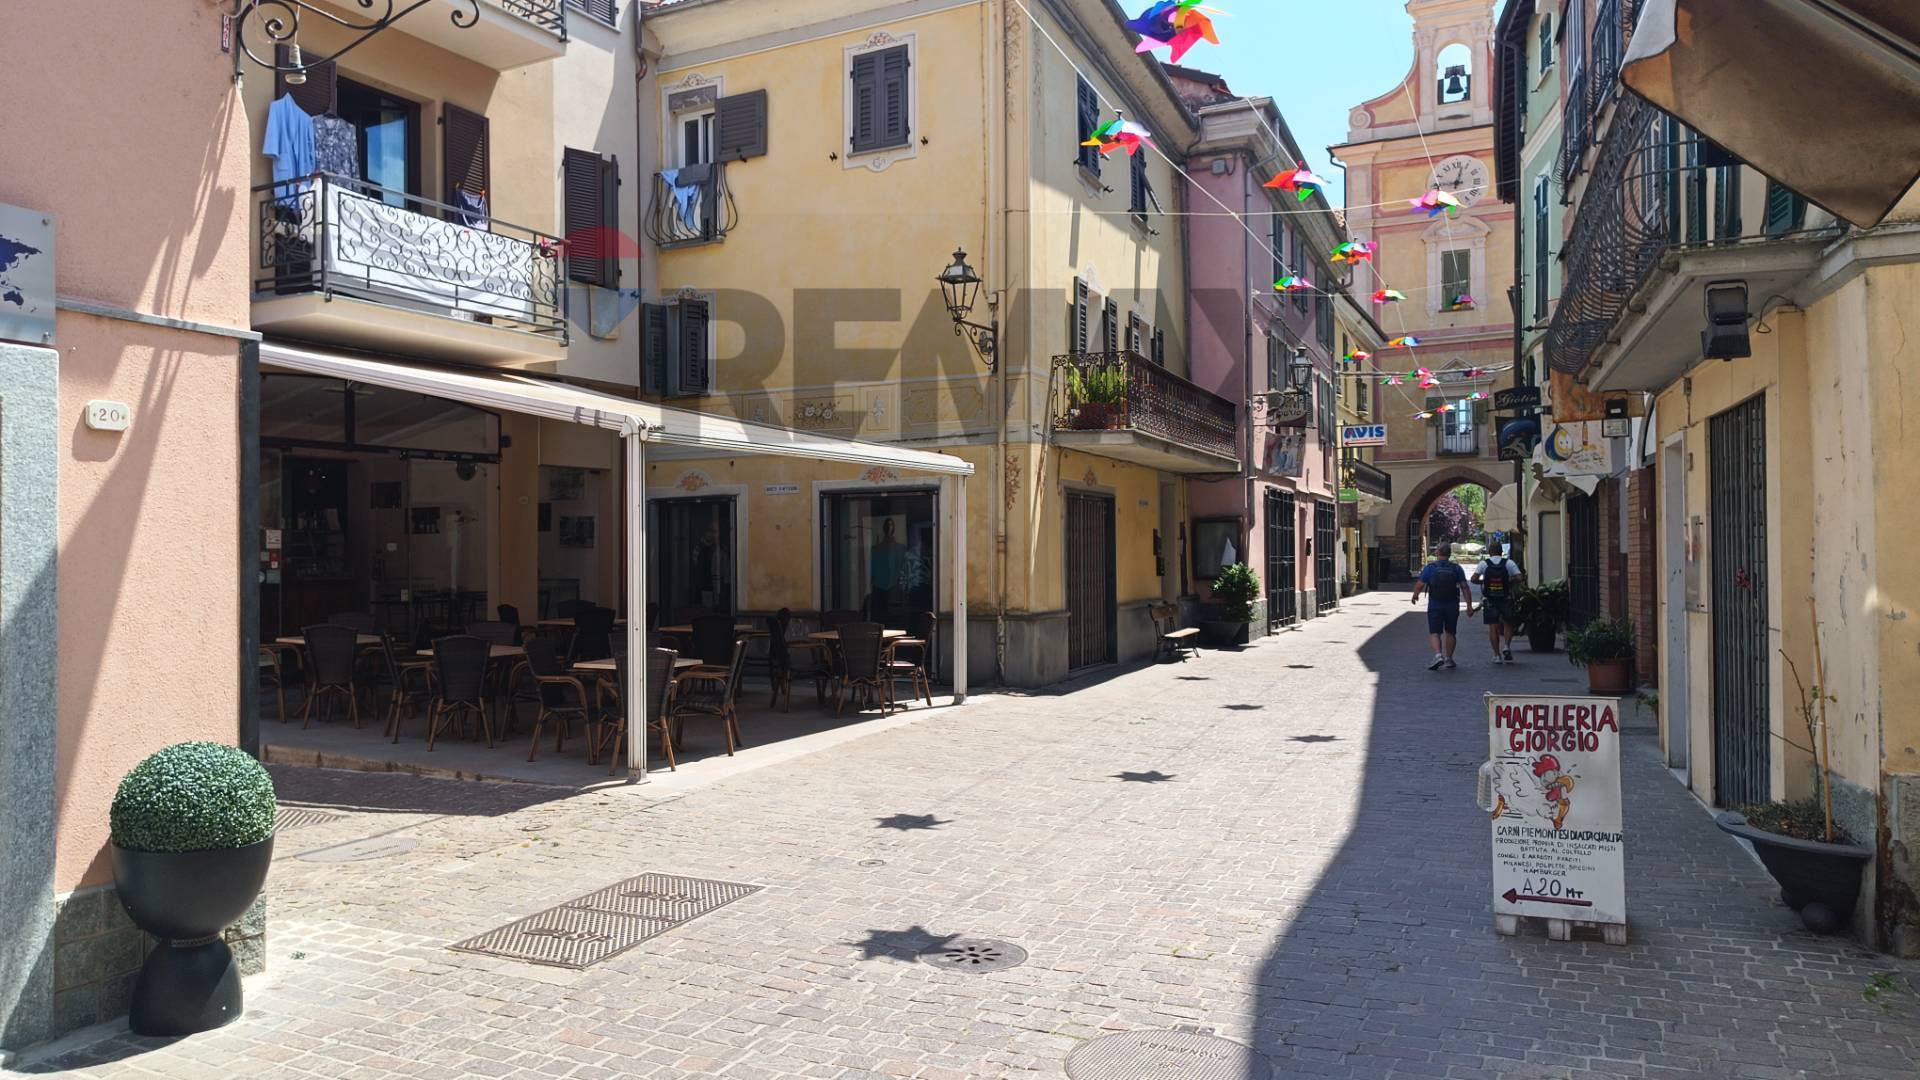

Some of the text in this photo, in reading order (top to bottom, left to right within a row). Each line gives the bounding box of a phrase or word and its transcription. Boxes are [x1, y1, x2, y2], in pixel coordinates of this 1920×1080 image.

[99, 408, 119, 422] 20
[1343, 426, 1385, 439] AVIS
[1495, 704, 1618, 733] MACELLERIA
[1509, 729, 1599, 752] GIORGIO
[1497, 825, 1520, 837] CARNI
[1522, 827, 1569, 840] PIEMONTESI
[1523, 868, 1567, 877] HAMBURGER
[1522, 877, 1534, 895] A
[1537, 877, 1562, 897] 20
